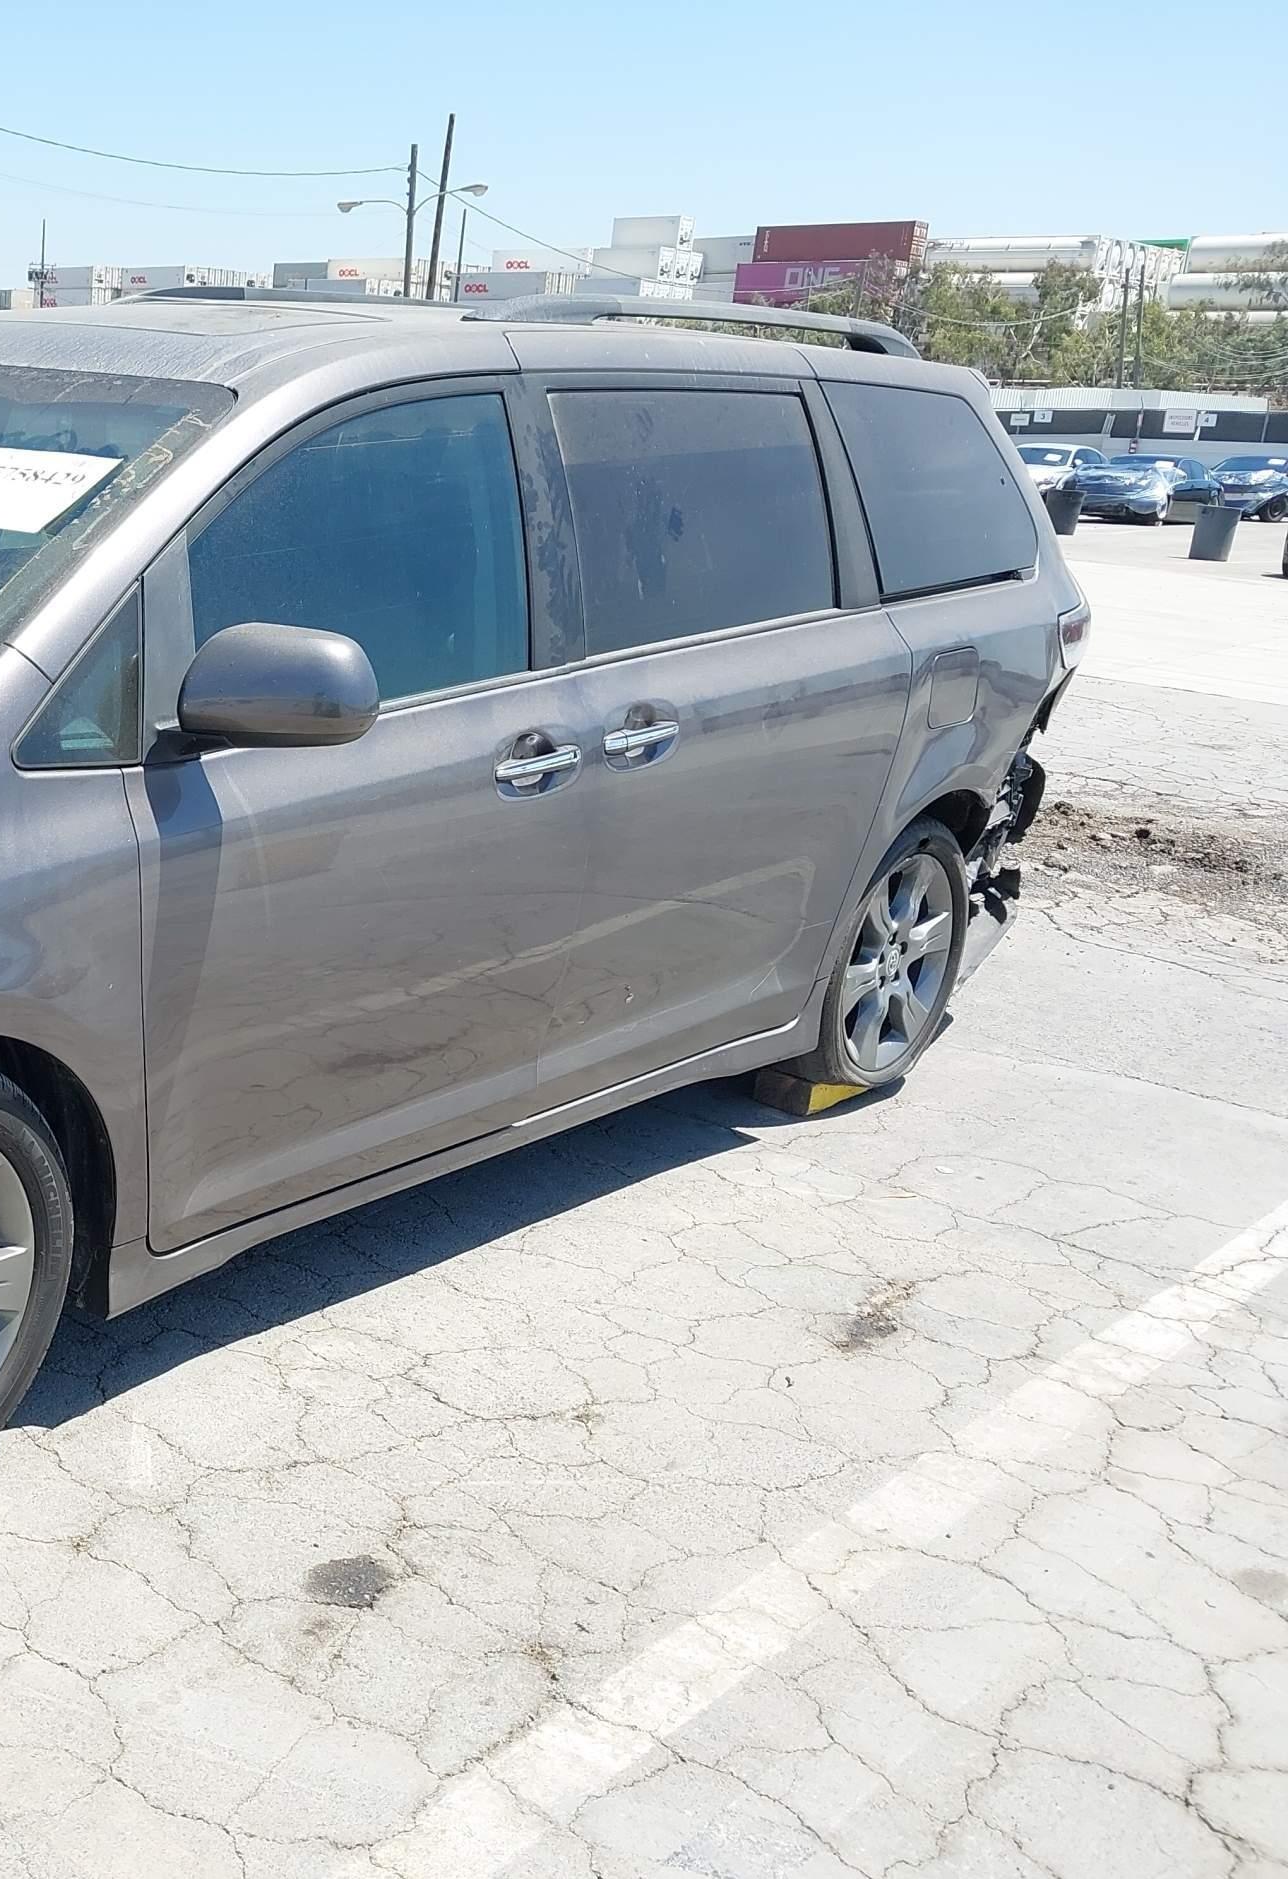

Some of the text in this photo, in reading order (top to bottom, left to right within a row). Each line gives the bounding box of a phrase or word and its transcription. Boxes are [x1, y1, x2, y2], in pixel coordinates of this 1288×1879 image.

[505, 260, 530, 269] OOCL
[338, 269, 359, 277] OOCL
[464, 284, 488, 293] OOCL
